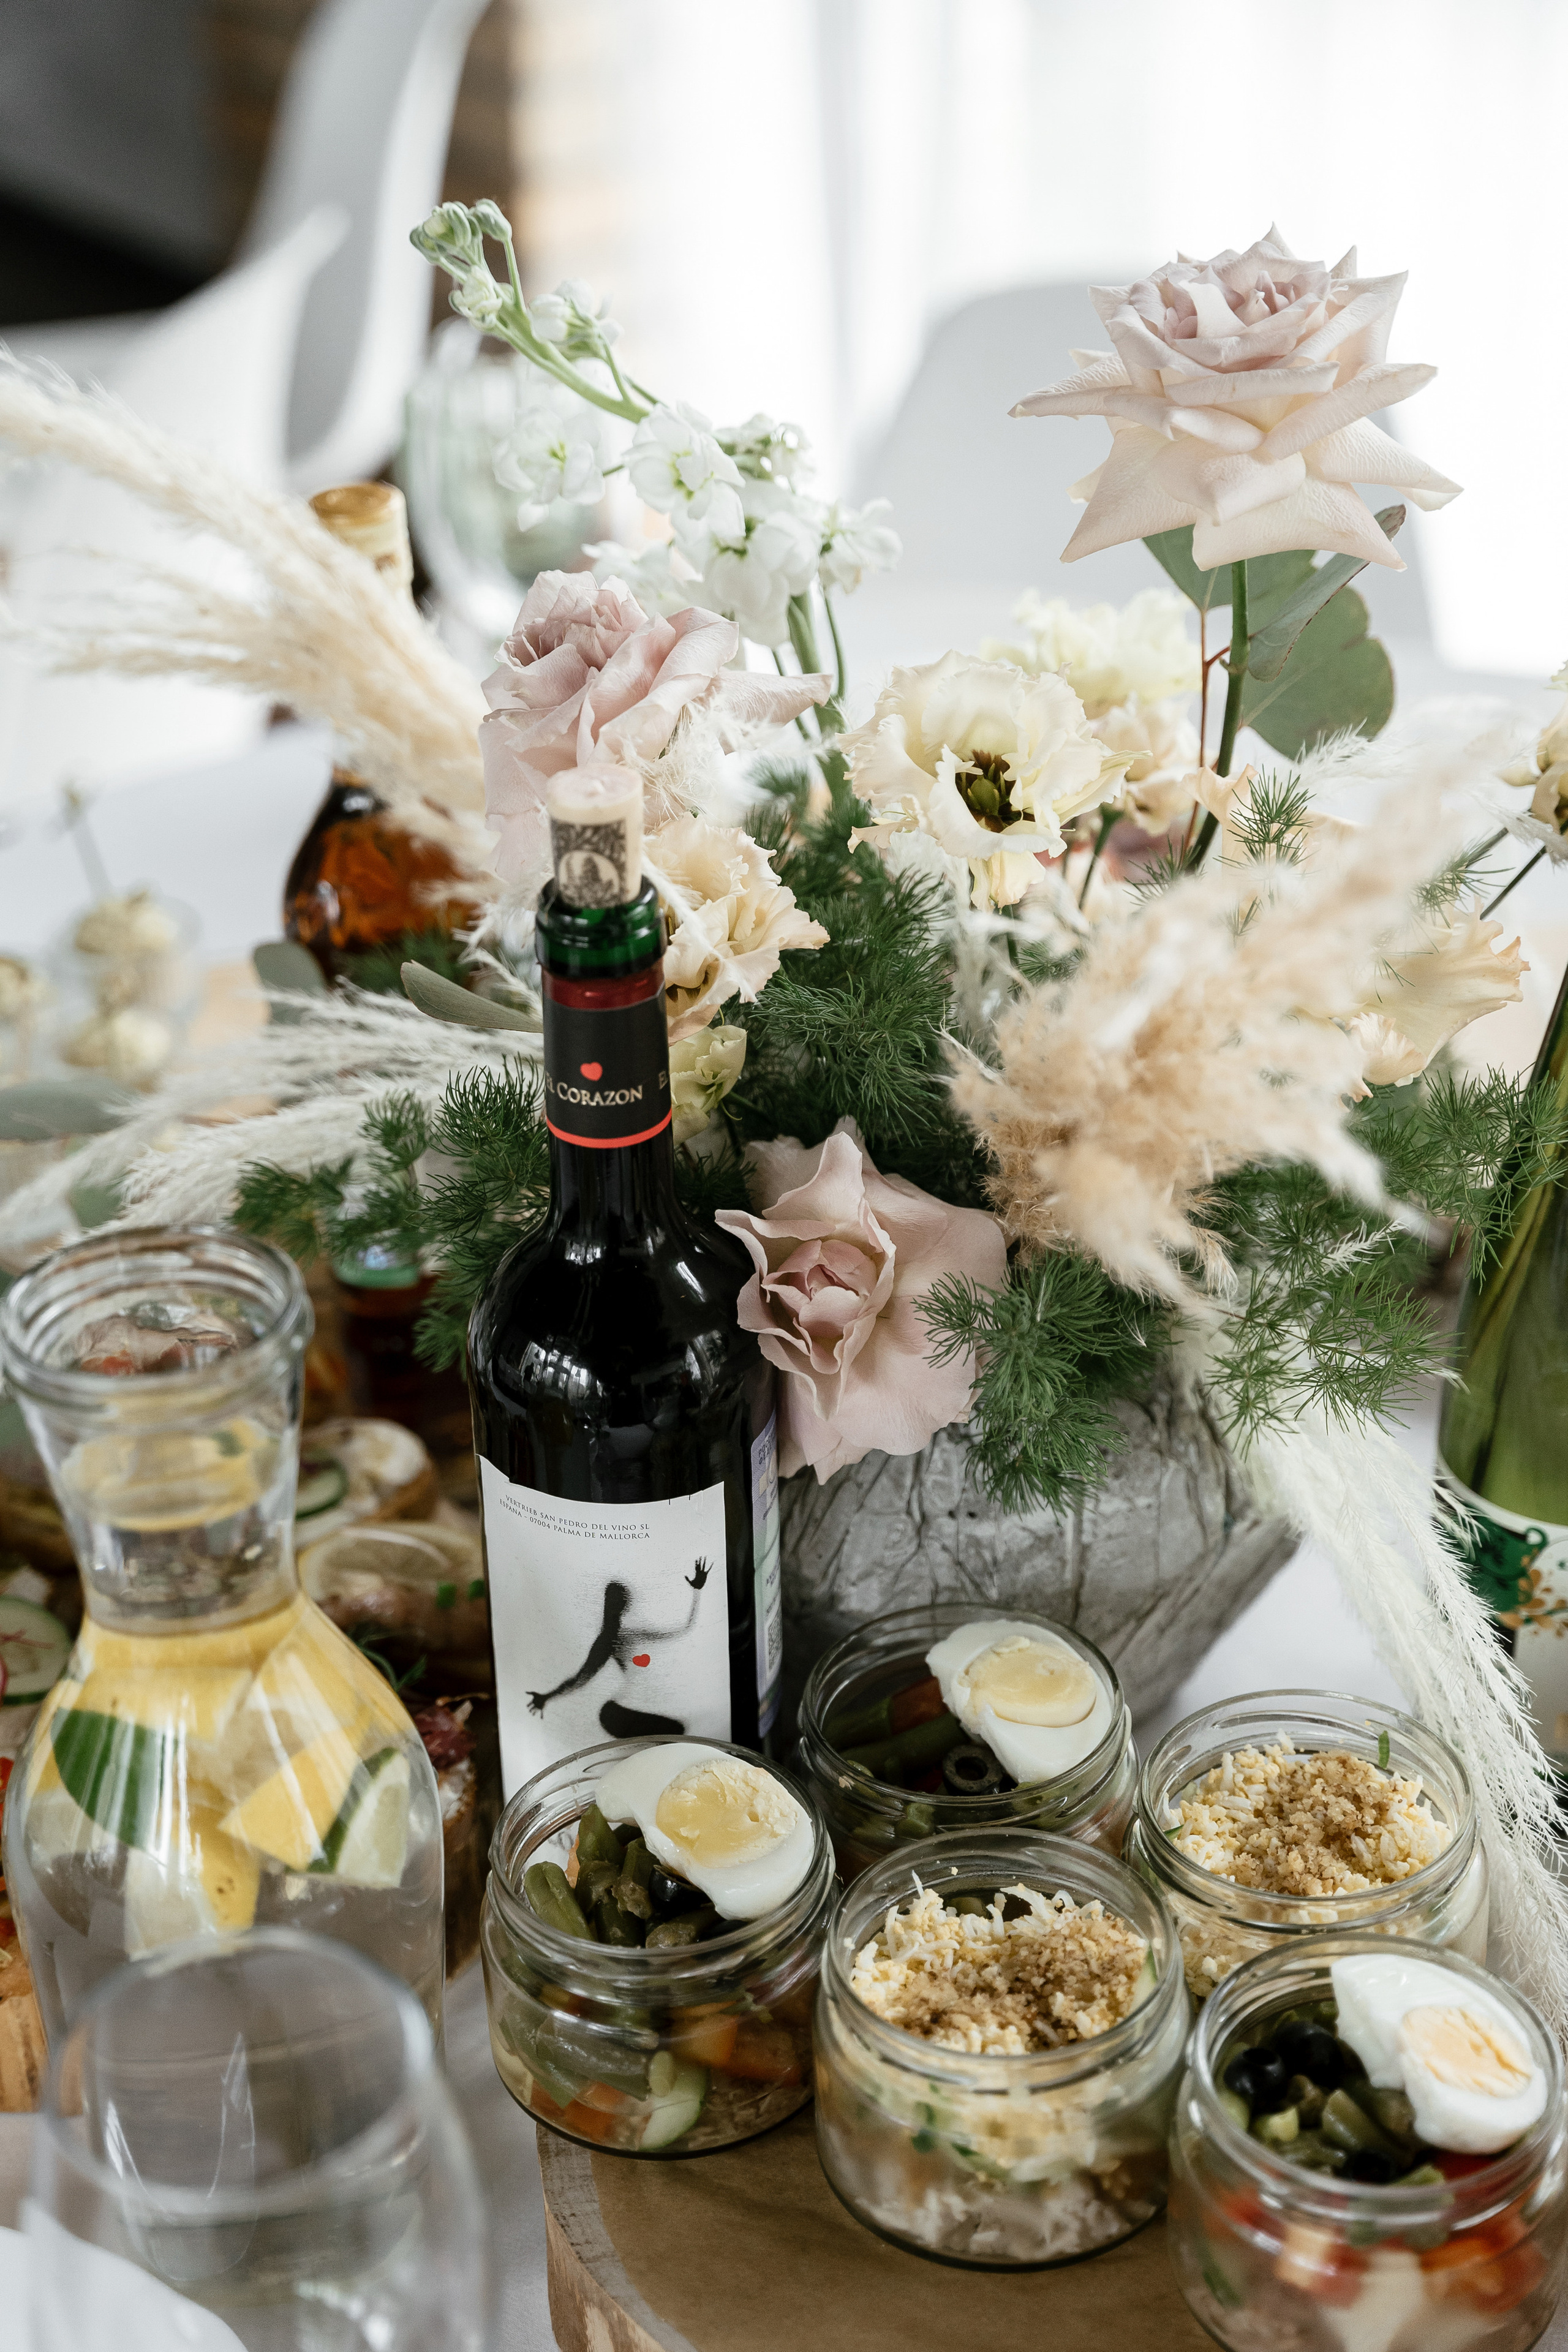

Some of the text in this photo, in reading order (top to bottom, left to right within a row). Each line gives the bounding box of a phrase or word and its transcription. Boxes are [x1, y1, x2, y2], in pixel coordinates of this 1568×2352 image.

[557, 1082, 643, 1106] CORAZON
[499, 1499, 522, 1518] ESPANA
[529, 1517, 551, 1529] 07004
[554, 1525, 581, 1537] PALMA
[506, 1494, 537, 1515] VERTRIEB
[540, 1512, 556, 1521] SAN
[559, 1518, 587, 1529] PEDRO
